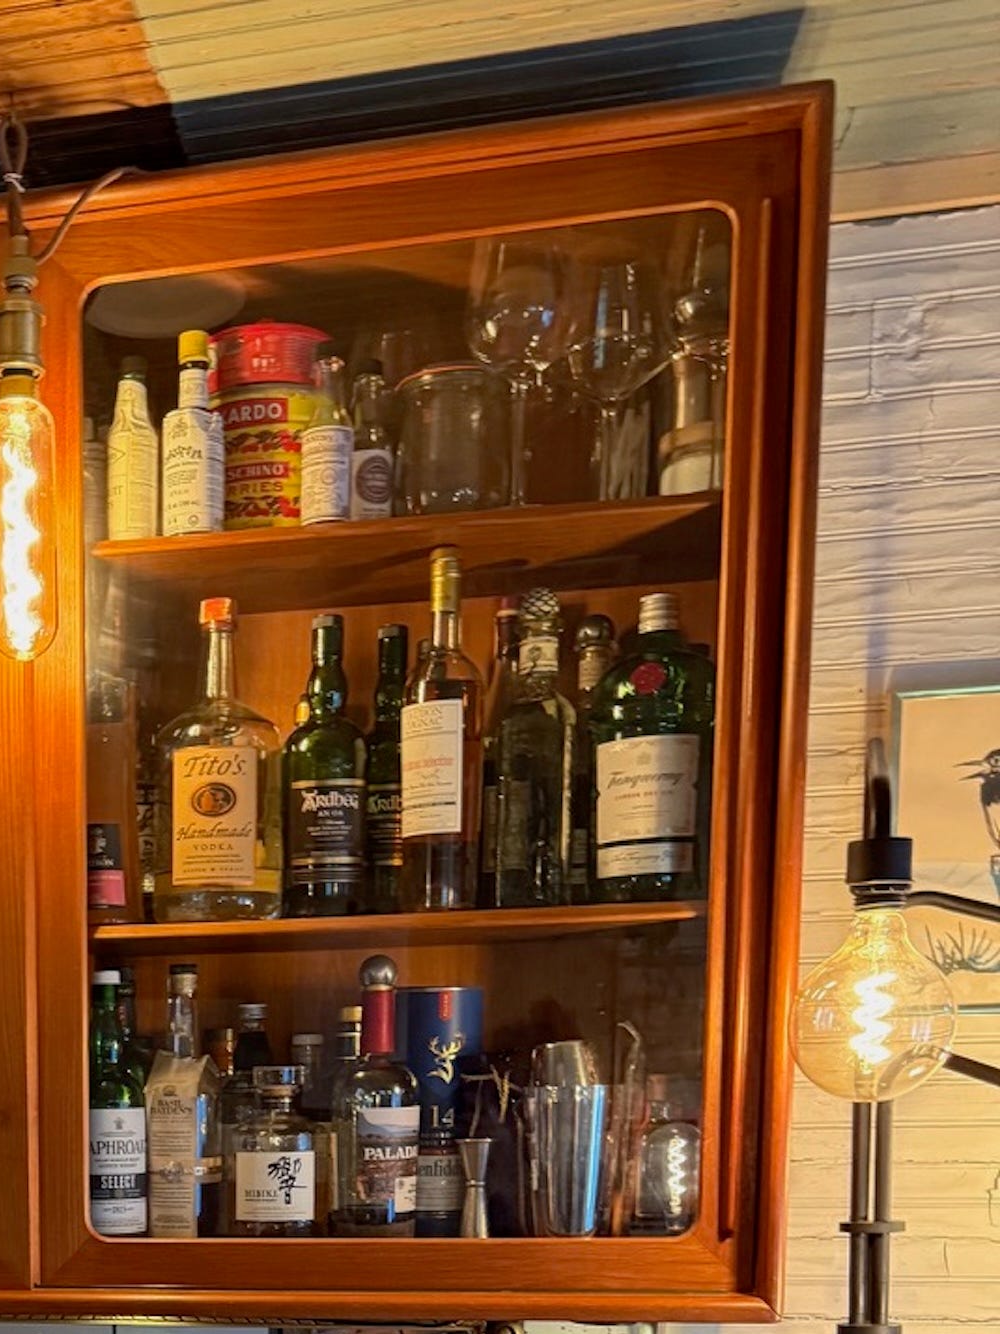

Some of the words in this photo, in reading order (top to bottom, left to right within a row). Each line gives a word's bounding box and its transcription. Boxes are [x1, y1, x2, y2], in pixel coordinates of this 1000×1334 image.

[183, 754, 247, 778] Tito's
[606, 771, 685, 789] Tanqueray
[301, 789, 360, 812] Ardbeg
[176, 821, 252, 841] Handmade
[192, 843, 234, 851] VODKA
[431, 1104, 456, 1128] 14
[100, 1174, 137, 1190] SELECT
[244, 1189, 278, 1198] HIBIKI
